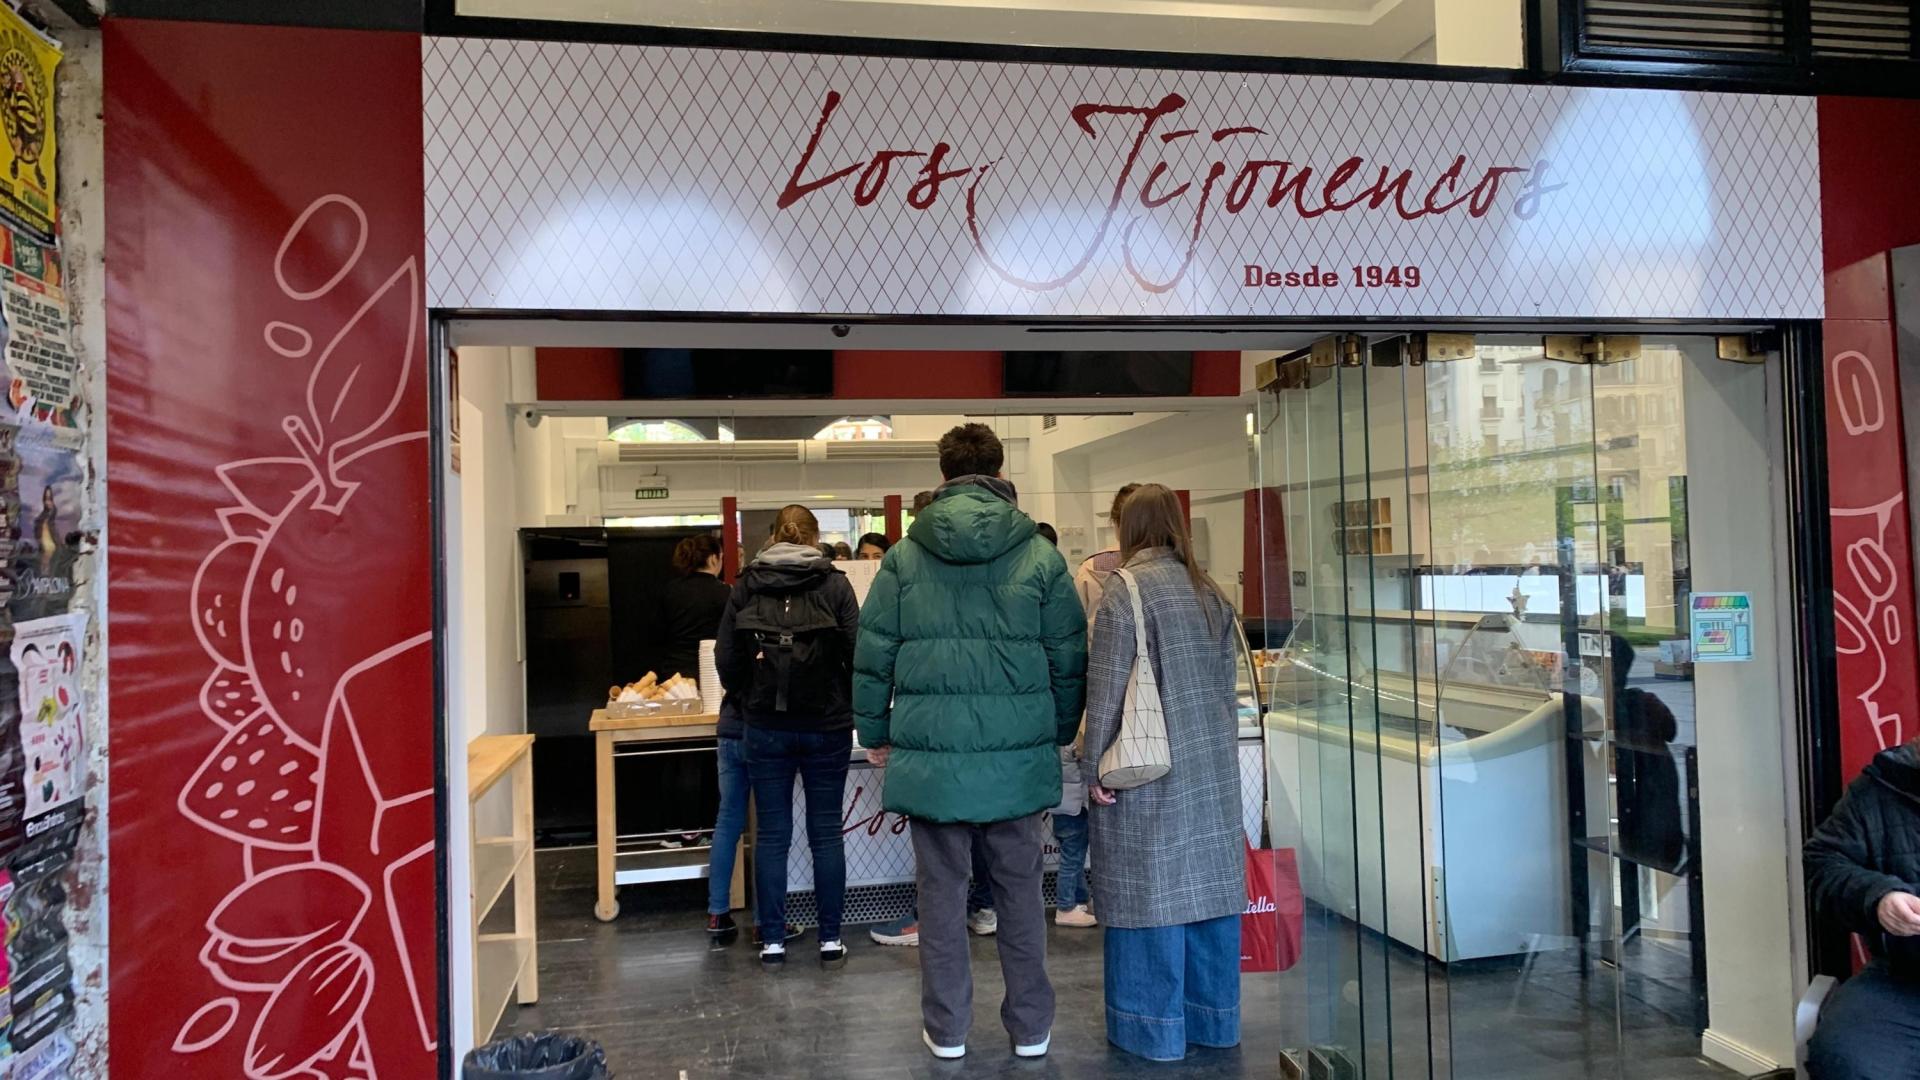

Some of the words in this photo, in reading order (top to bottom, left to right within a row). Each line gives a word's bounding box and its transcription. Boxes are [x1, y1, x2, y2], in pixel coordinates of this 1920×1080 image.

[777, 90, 973, 210] Los
[967, 93, 1569, 293] Jijonencos
[1244, 264, 1339, 288] Desde
[1352, 265, 1421, 288] 1949
[1243, 895, 1276, 914] tella
